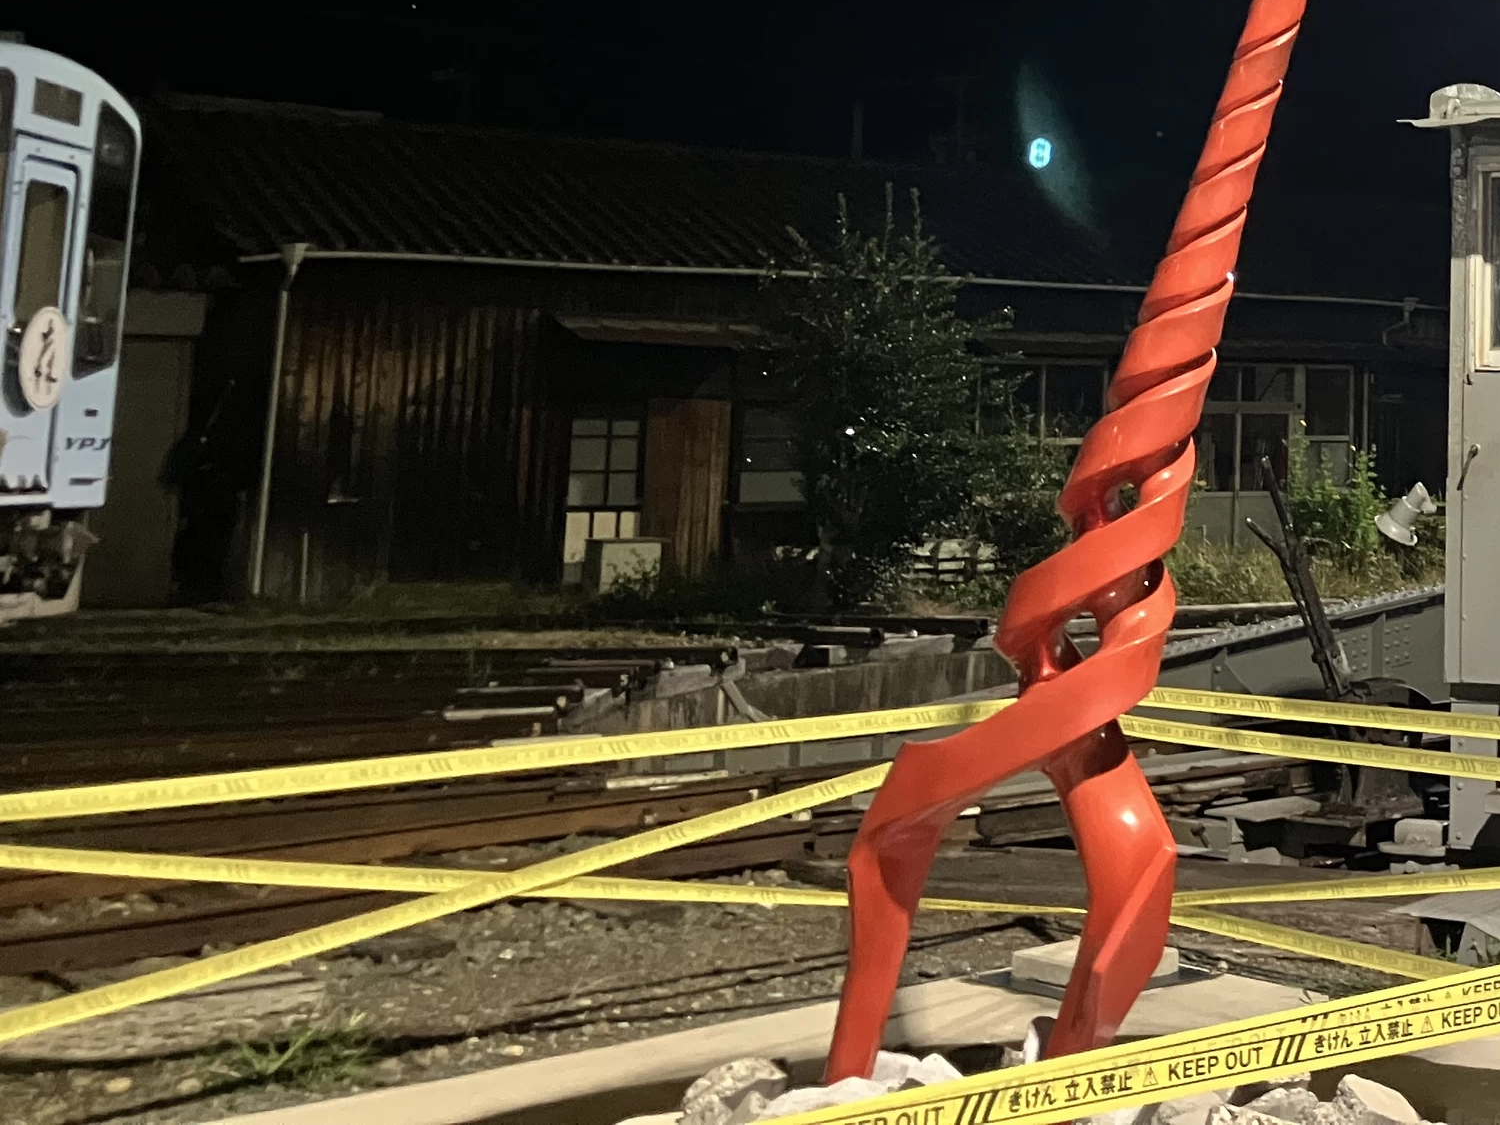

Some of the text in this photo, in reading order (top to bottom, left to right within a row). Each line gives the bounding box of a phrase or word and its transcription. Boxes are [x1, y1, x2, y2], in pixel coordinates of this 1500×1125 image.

[1009, 1084, 1055, 1113] きけん
[1064, 1069, 1132, 1101] 立入禁止
[1168, 1055, 1218, 1081] KEEP
[1225, 1046, 1262, 1069] OUT
[1314, 1029, 1352, 1053] きけん
[1358, 1017, 1412, 1044] 立入禁止
[1441, 1005, 1482, 1029] KEEP
